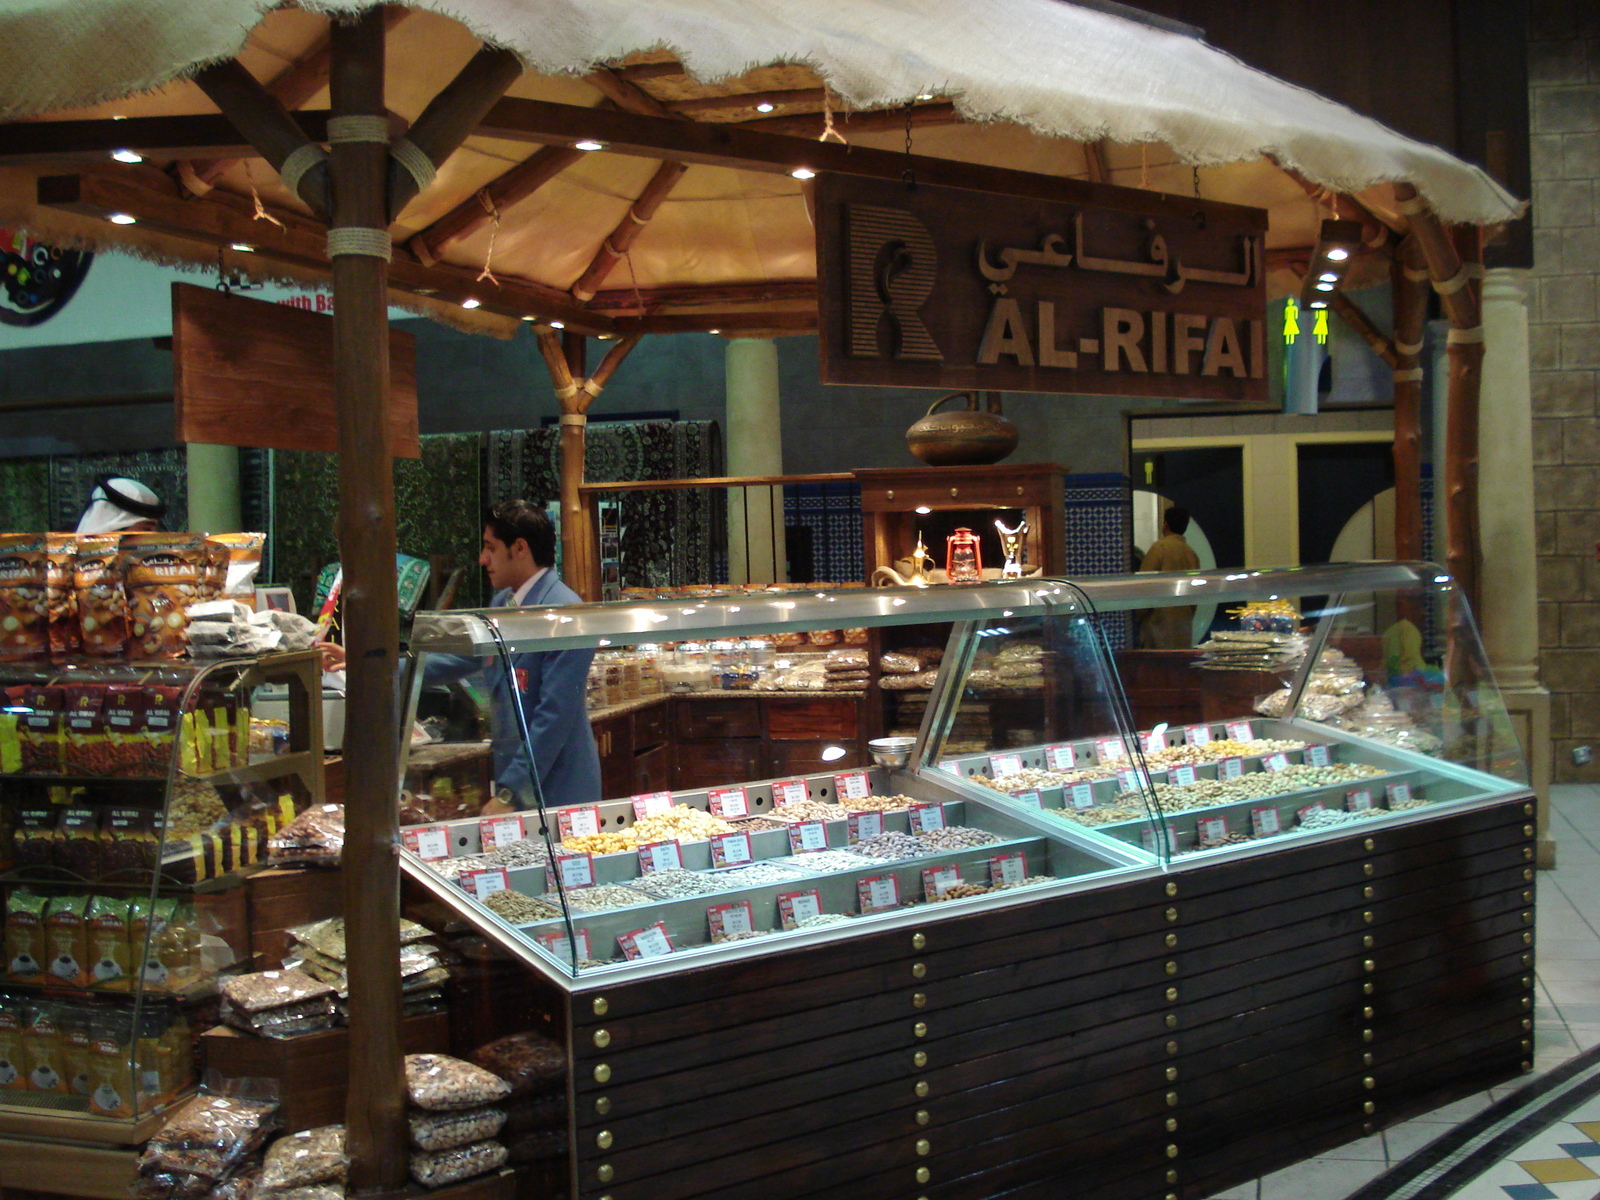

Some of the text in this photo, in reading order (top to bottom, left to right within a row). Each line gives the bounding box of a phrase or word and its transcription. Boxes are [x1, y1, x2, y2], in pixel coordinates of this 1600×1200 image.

[977, 212, 1258, 296] الرفاعي
[977, 297, 1265, 379] AL-RIFAI
[155, 565, 196, 576] RIFAI
